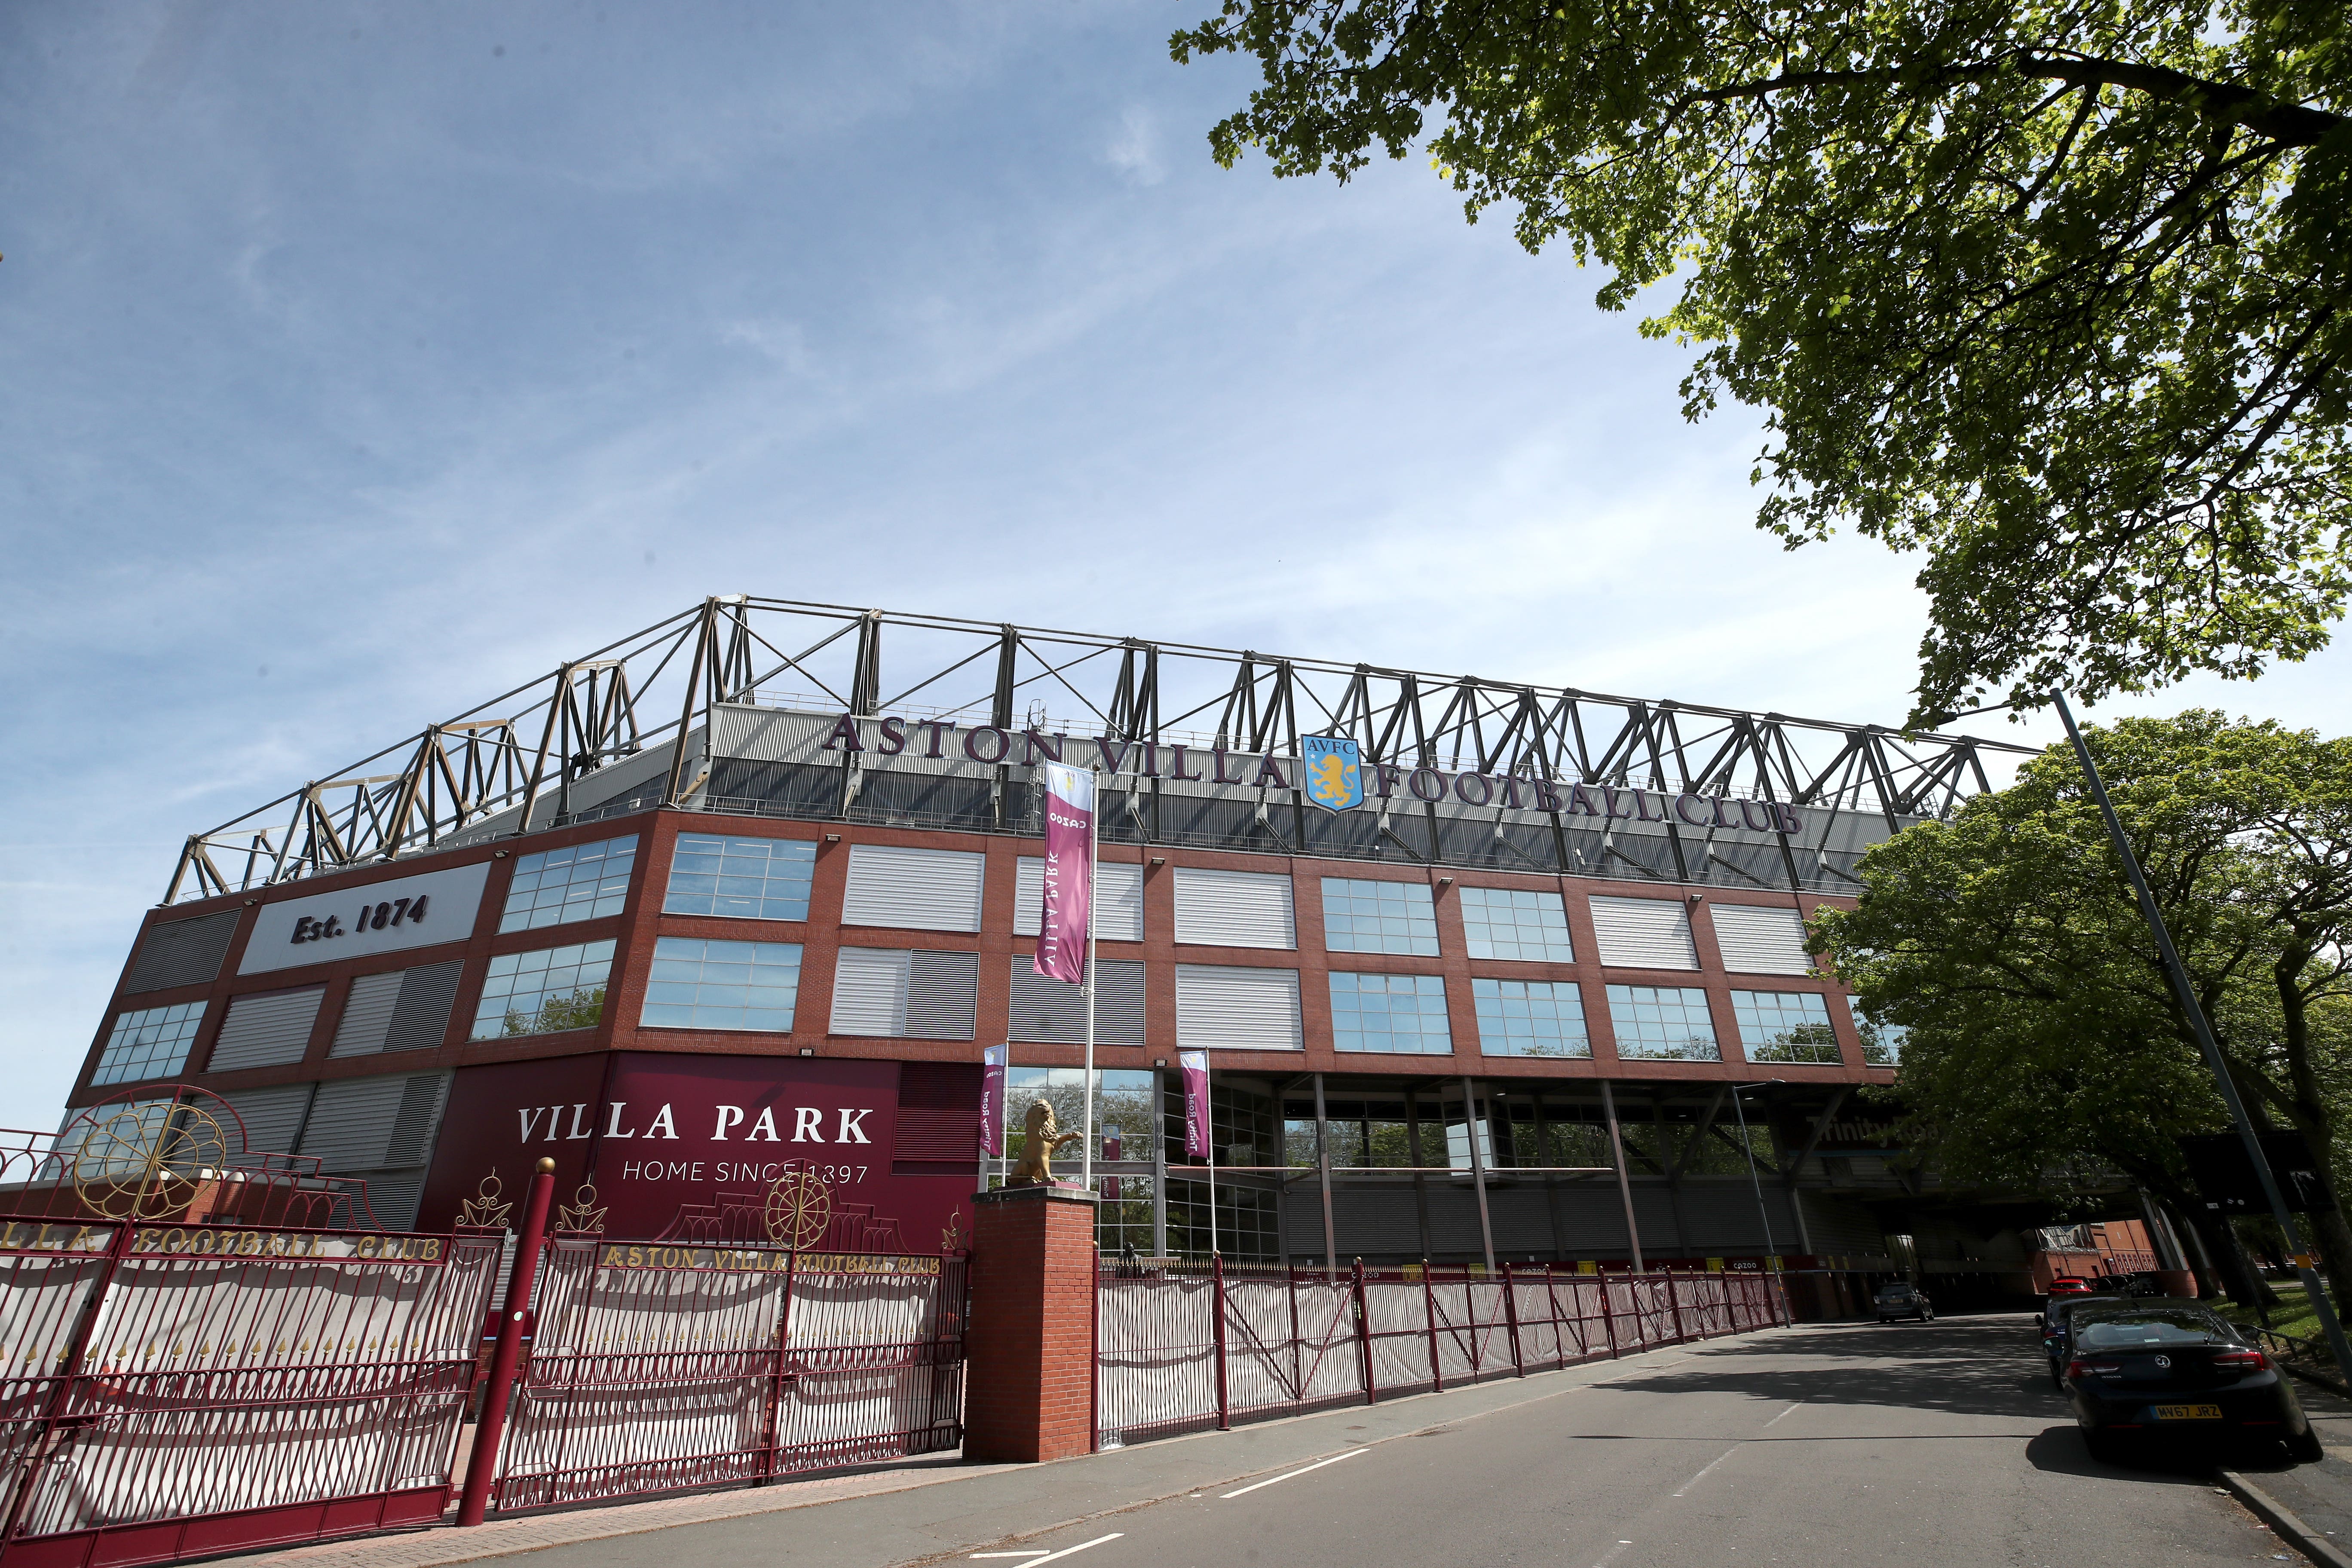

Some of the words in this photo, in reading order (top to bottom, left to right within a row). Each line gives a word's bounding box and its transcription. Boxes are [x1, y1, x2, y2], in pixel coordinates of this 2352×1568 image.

[1307, 739, 1355, 755] AVFC
[821, 712, 1068, 766] ASTON
[1093, 736, 1290, 788] VILLA
[1373, 763, 1663, 822] FOOTBALL
[1675, 793, 1802, 834] CLUB
[290, 914, 343, 944] Est.
[355, 895, 428, 932] 1874
[518, 1102, 680, 1144] VILLA
[710, 1105, 873, 1144] PARK
[623, 1160, 705, 1181] HOME
[715, 1162, 796, 1183] SINCE
[807, 1165, 868, 1184] 1897
[134, 1228, 326, 1258] FOOTBALL
[358, 1236, 441, 1261] CLUB
[603, 1245, 699, 1269] ASTON
[714, 1250, 787, 1272] VILLA
[793, 1254, 892, 1274] FOOTBALL
[898, 1256, 941, 1275] CLUB
[2157, 1406, 2190, 1418] MV67
[2196, 1406, 2220, 1417] JRZ
